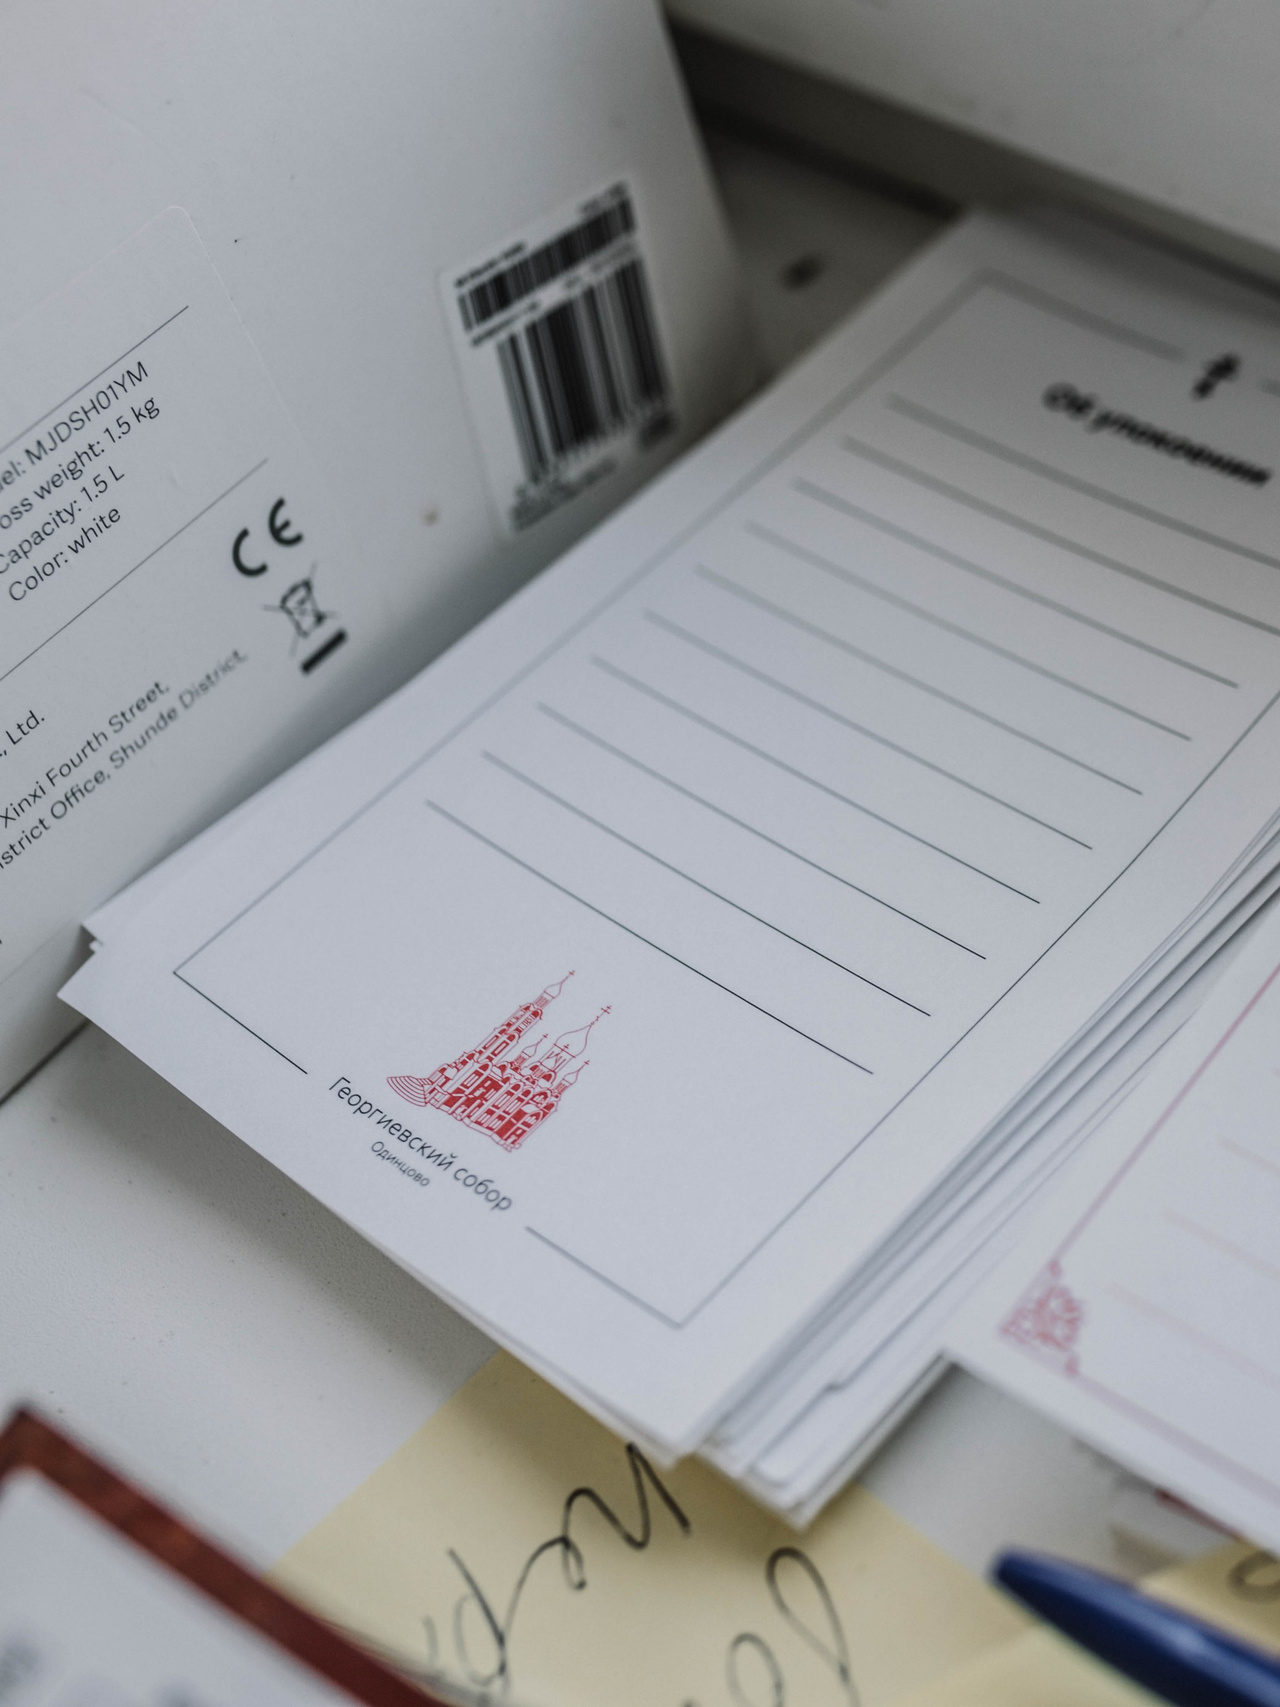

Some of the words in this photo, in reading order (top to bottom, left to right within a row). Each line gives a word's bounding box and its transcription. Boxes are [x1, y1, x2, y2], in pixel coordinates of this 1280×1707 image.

[0, 460, 26, 493] el:
[25, 361, 149, 466] MJDSH01YM
[33, 441, 105, 500] weight:
[103, 416, 132, 444] 1.5
[131, 397, 160, 424] kg
[80, 474, 108, 502] 1.5
[108, 465, 125, 482] L
[9, 552, 69, 601] Color:
[68, 506, 122, 554] white
[5, 710, 45, 746] Ltd.
[109, 706, 178, 769] Shunde
[0, 781, 47, 828] Xinxi
[46, 729, 109, 787] Fourth
[329, 1076, 457, 1171] Георгиевский
[453, 1168, 513, 1212] собор
[371, 1141, 431, 1187] Одинцово
